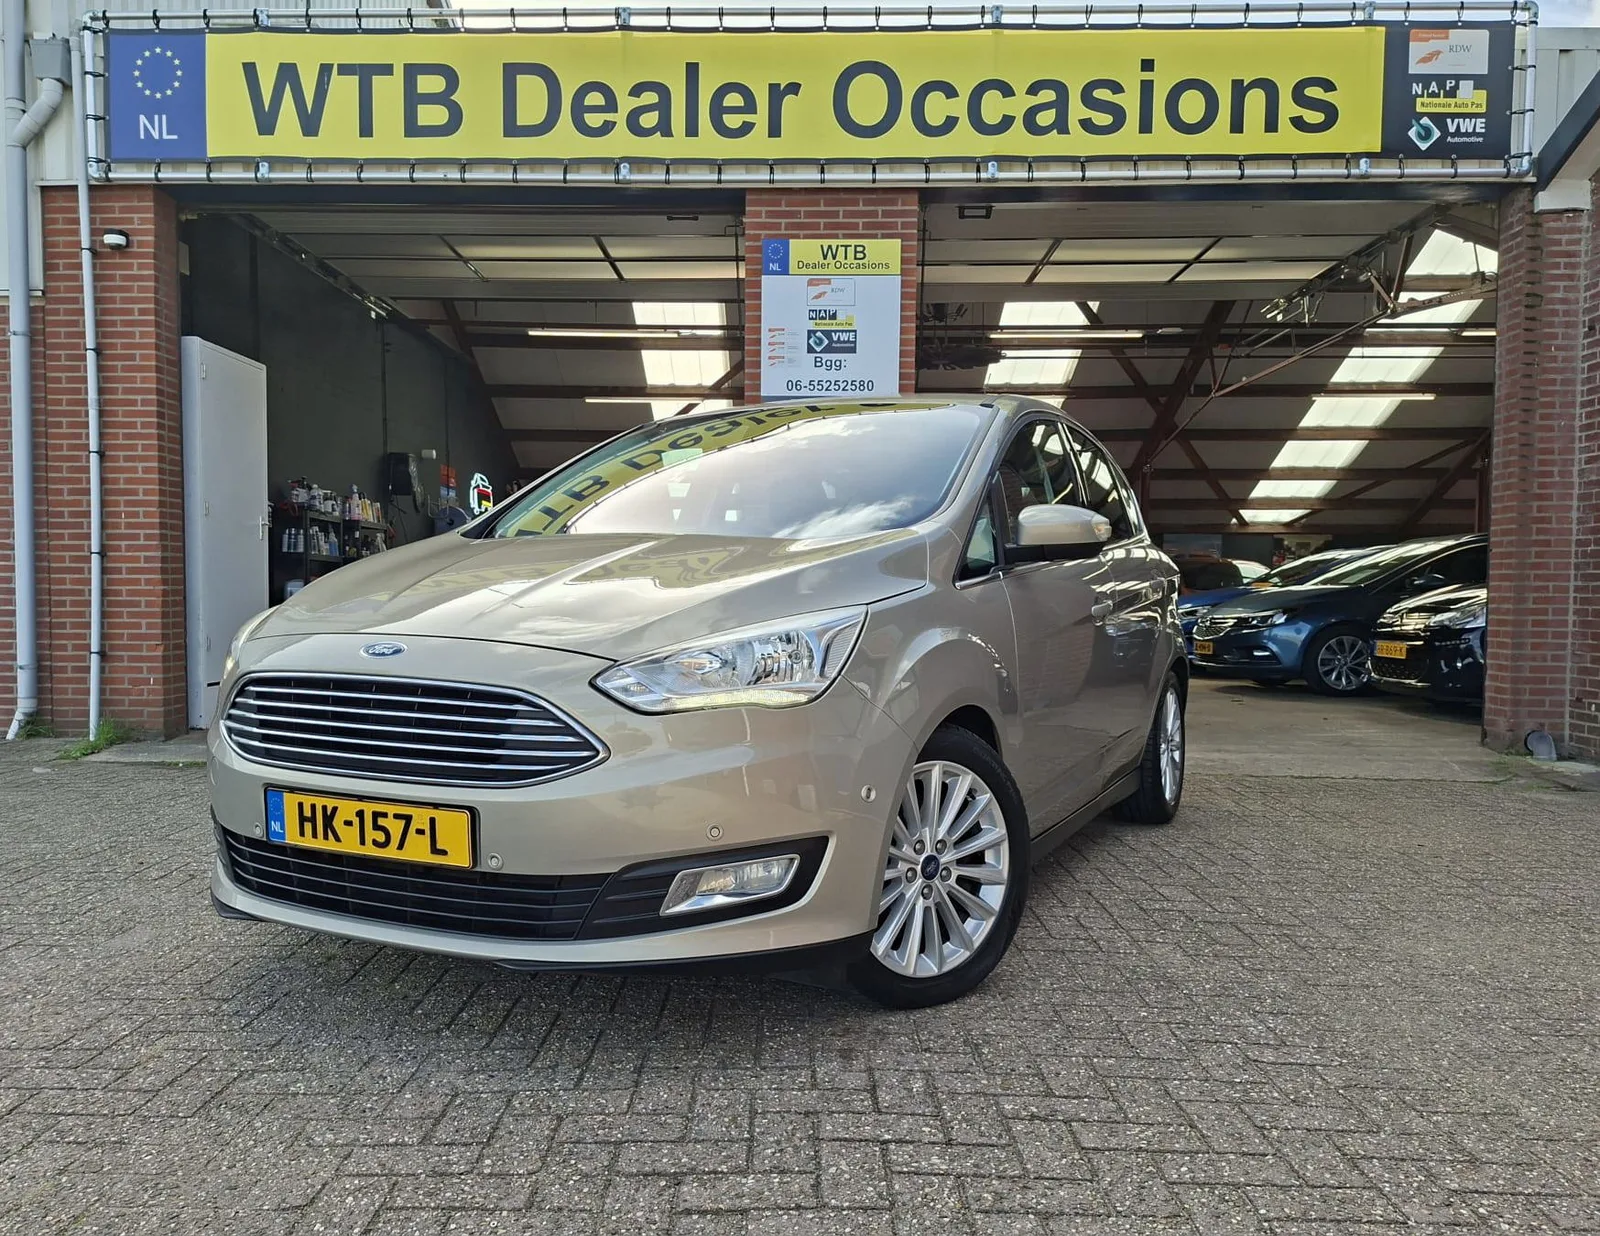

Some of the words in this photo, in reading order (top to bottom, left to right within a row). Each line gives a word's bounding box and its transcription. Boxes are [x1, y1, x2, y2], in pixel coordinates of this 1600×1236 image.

[1449, 45, 1472, 53] RDW
[242, 61, 464, 139] WTB
[502, 61, 801, 139] Dealer
[832, 59, 1340, 139] Occasions
[1420, 101, 1452, 109] Nationale
[1453, 101, 1469, 109] Auto
[1470, 101, 1483, 109] Pas
[139, 114, 178, 140] NL
[1446, 118, 1486, 133] VWE
[820, 244, 867, 260] WTB
[769, 262, 782, 271] NL
[797, 260, 830, 270] Dealer
[834, 260, 890, 270] Occasions
[810, 309, 836, 319] NAP
[832, 332, 856, 342] VWE
[813, 356, 848, 372] Bgg:
[786, 379, 874, 392] 06-55252580
[367, 644, 399, 655] Ford
[271, 821, 284, 834] NL
[297, 802, 449, 857] HK-157-L
